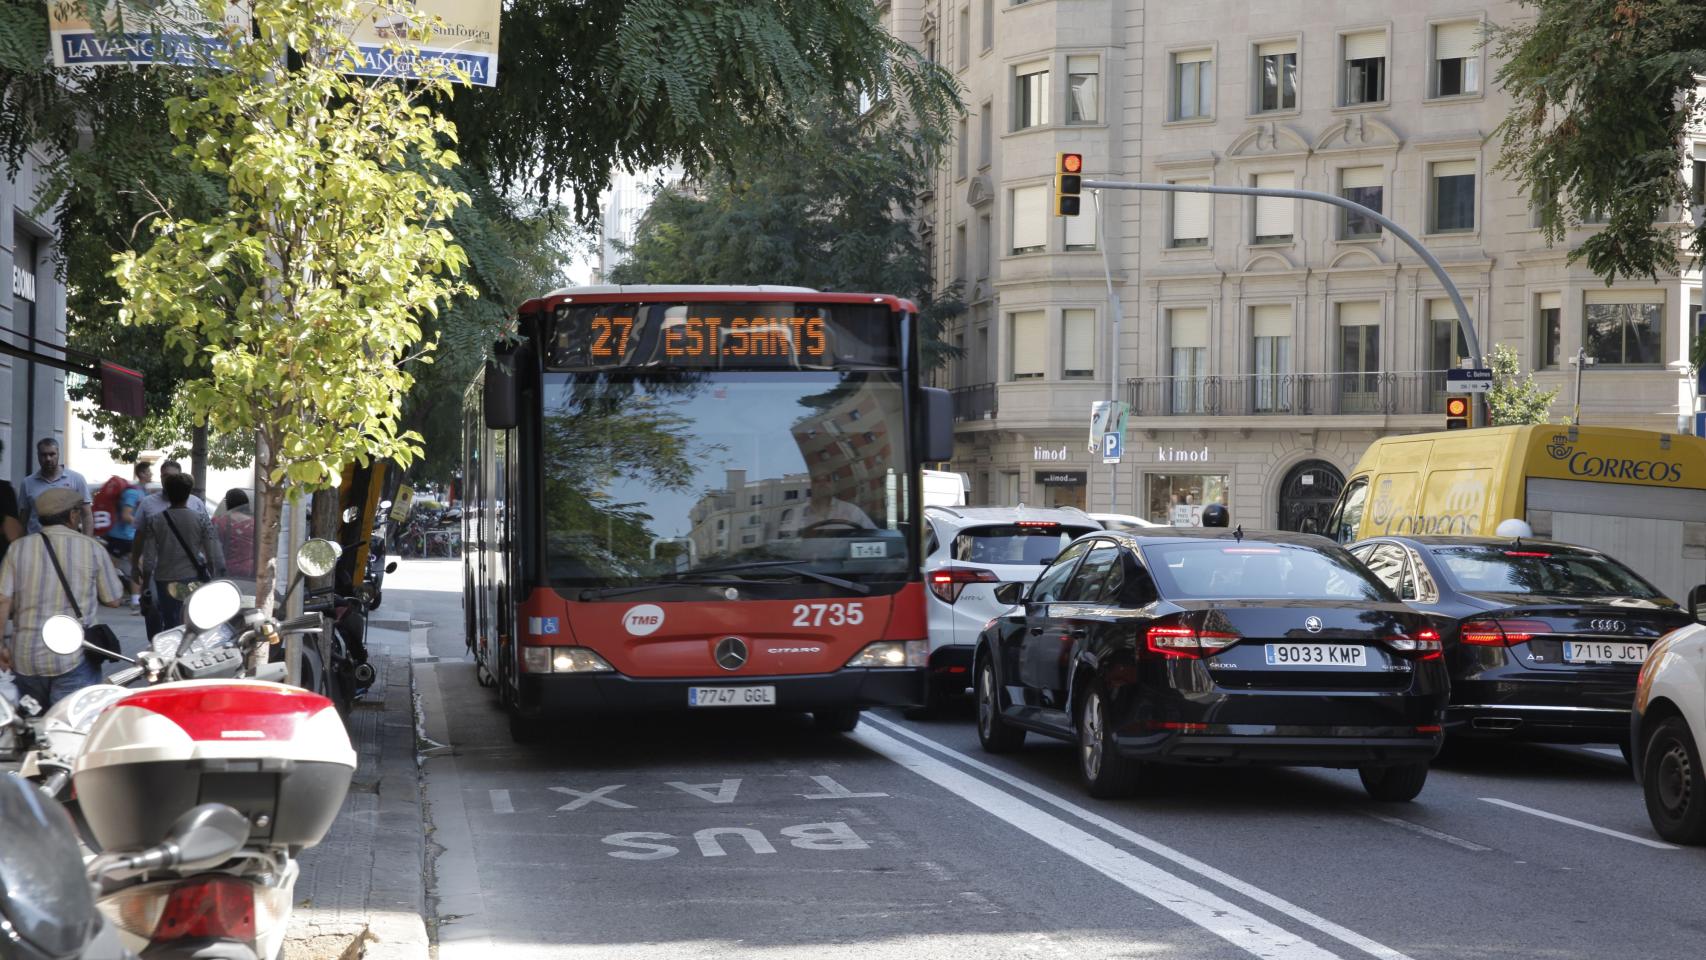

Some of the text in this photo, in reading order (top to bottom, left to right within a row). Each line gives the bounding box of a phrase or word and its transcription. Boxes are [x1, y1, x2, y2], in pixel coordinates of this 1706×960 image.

[591, 317, 632, 355] 27
[1033, 446, 1067, 461] kimod
[1106, 434, 1117, 456] P
[1159, 446, 1208, 461] kimod
[1568, 451, 1683, 483] CORREOS
[855, 545, 882, 556] T-14
[631, 615, 659, 625] TMB
[792, 602, 864, 627] 2735
[1278, 646, 1361, 664] 9033 KMP
[1574, 644, 1645, 660] 7116 JCT
[699, 688, 771, 703] 7747 GGL
[488, 774, 890, 814] TAXI
[602, 821, 871, 861] BUS
